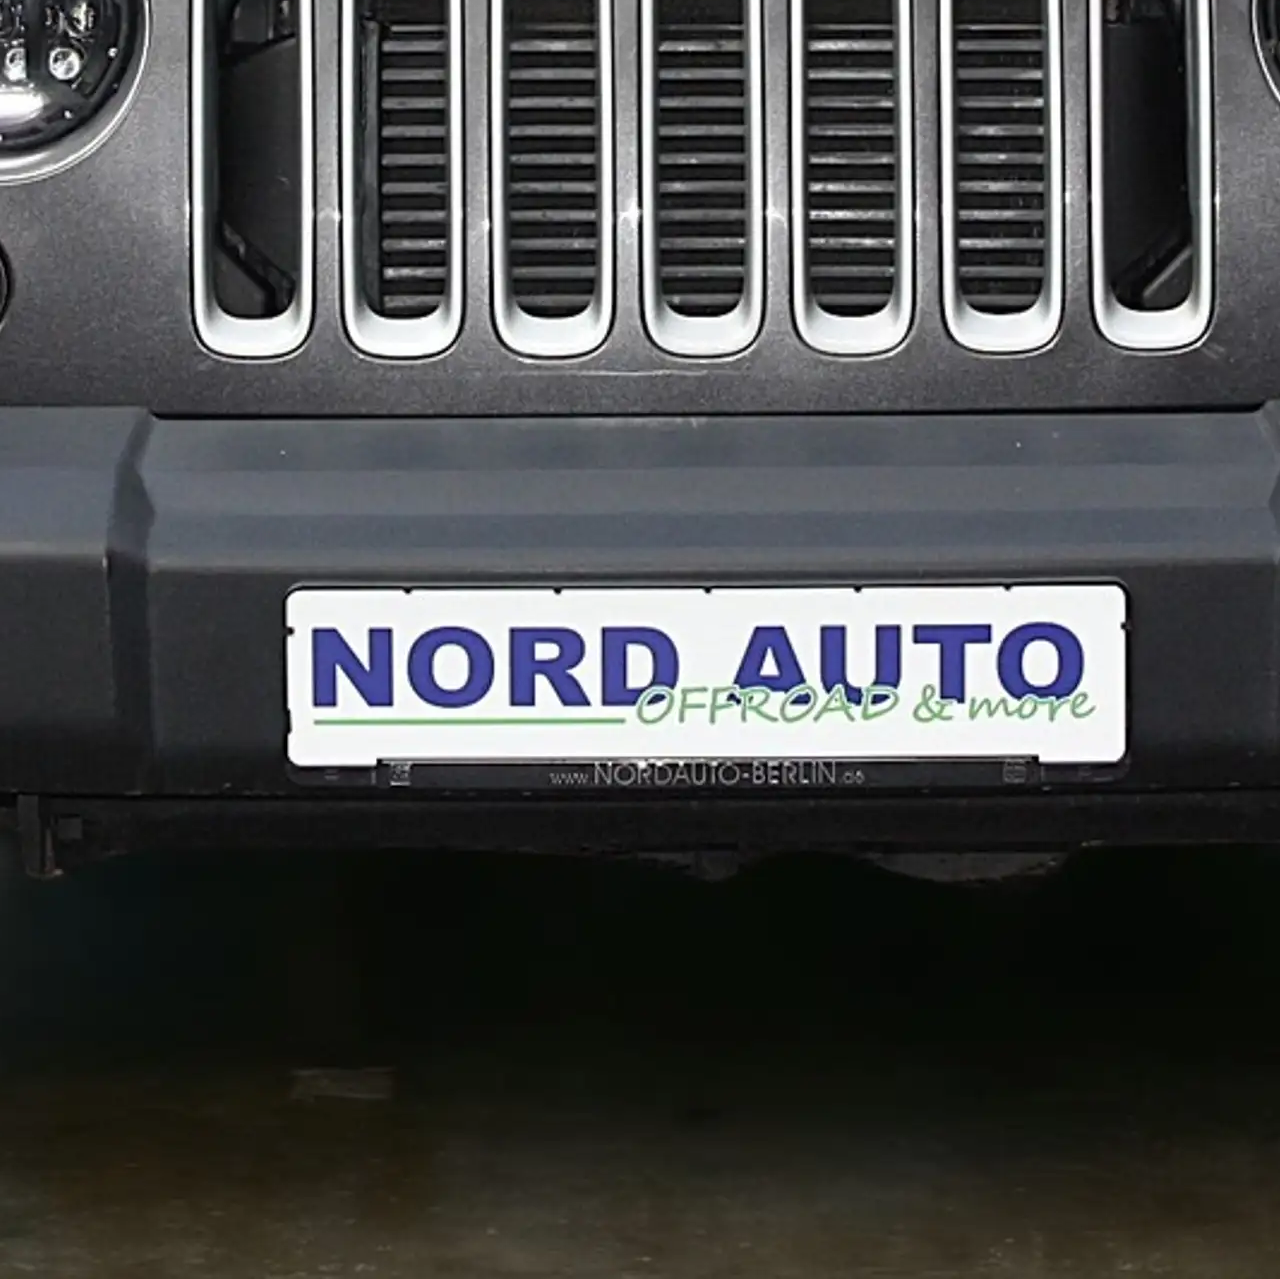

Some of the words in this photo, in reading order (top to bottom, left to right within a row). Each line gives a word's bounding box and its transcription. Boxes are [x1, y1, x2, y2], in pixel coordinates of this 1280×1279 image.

[312, 624, 680, 709] NORD
[728, 621, 1086, 707] AUTO
[636, 684, 900, 725] OFFROAD
[913, 683, 953, 722] &
[968, 691, 1096, 723] more
